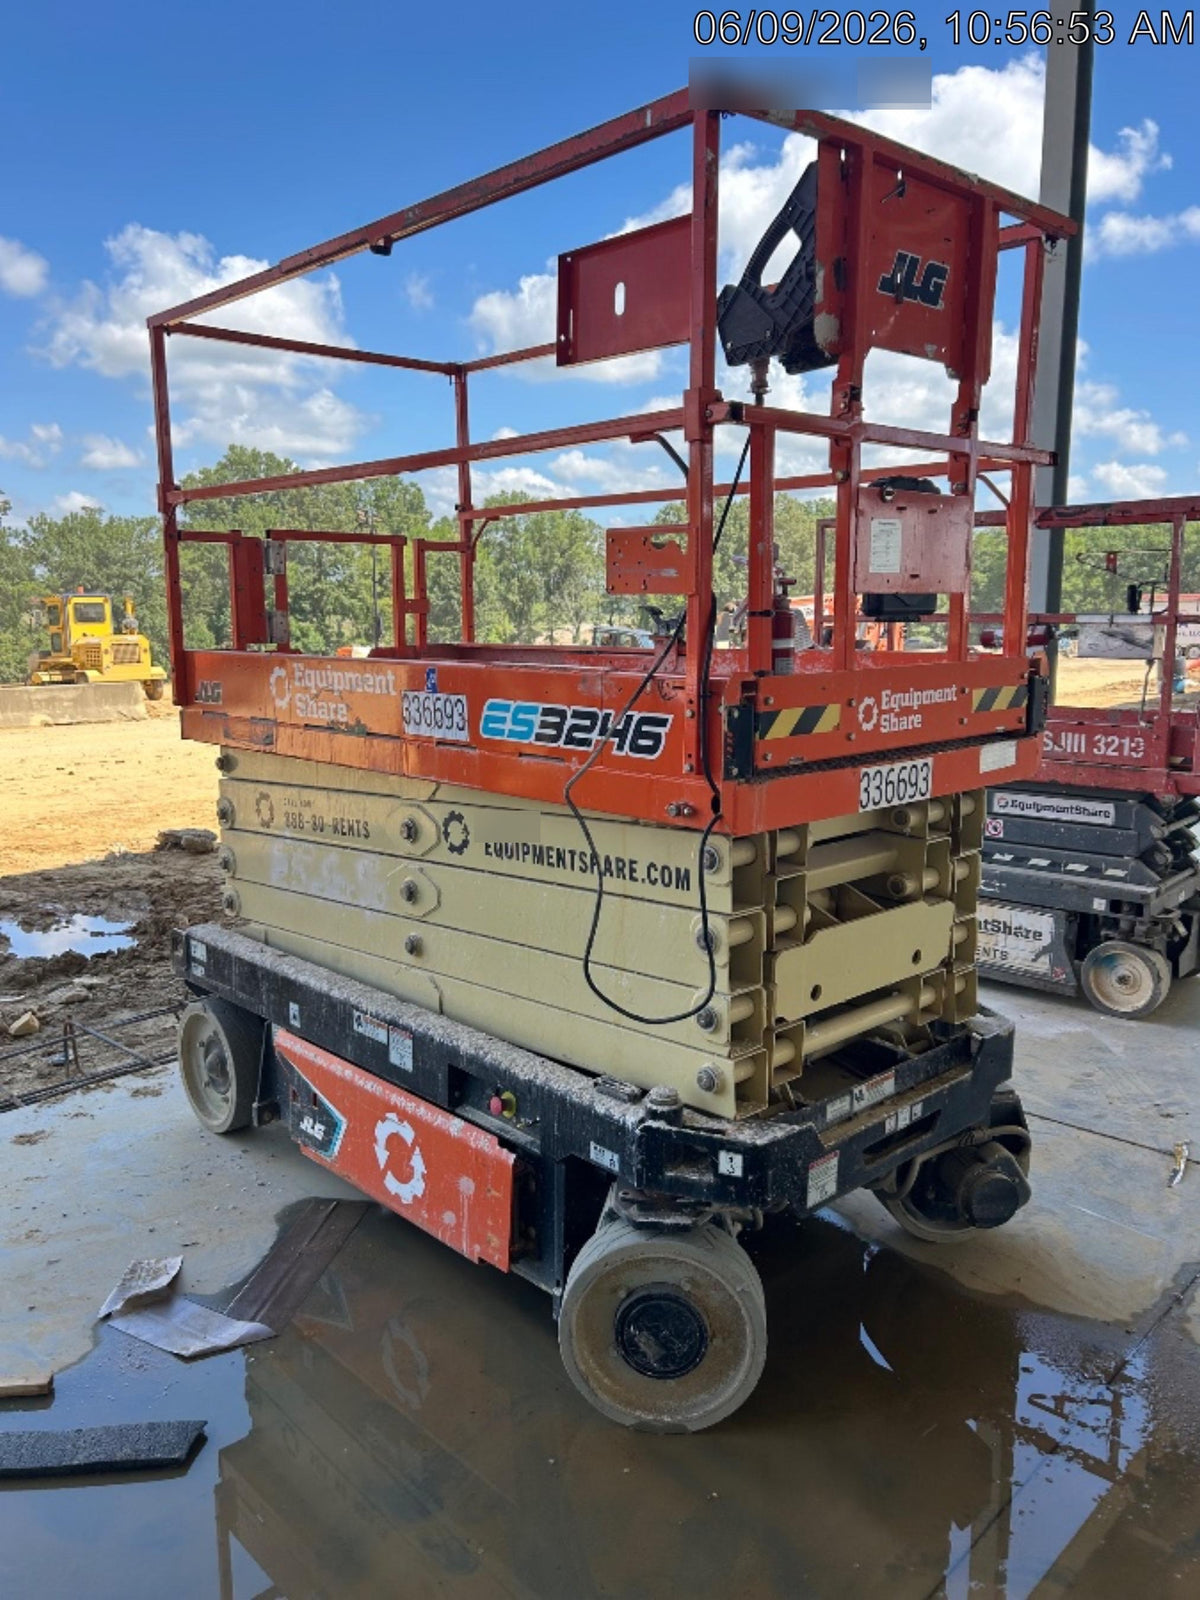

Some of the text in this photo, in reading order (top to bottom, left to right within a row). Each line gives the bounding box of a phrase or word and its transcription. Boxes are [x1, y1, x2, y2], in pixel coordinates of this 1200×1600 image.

[876, 249, 950, 310] JLG
[194, 680, 223, 705] JLG
[293, 663, 397, 696] Equipment
[294, 693, 348, 722] Share
[402, 692, 466, 731] 336693
[881, 684, 958, 712] Equipment
[480, 698, 674, 760] ES3246
[880, 712, 922, 734] Share
[859, 763, 931, 810] 336693
[1009, 799, 1112, 819] EquipmentShare
